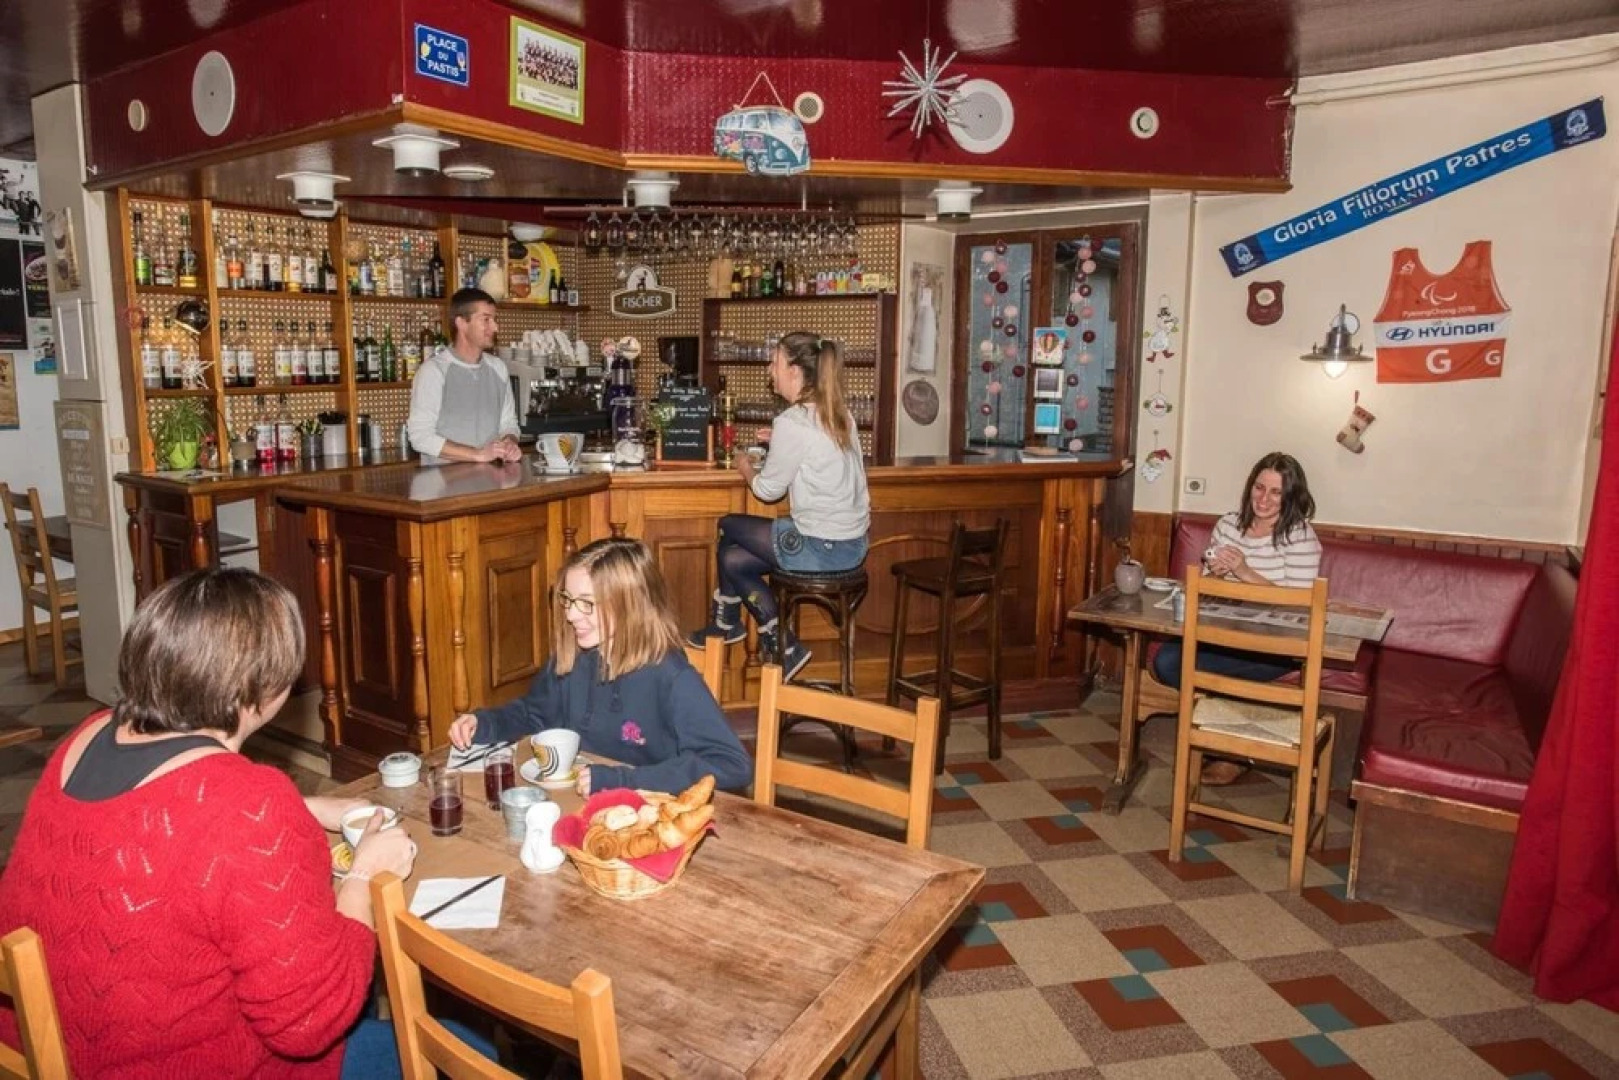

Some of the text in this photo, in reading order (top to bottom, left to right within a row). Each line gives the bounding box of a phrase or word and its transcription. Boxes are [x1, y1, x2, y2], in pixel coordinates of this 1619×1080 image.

[427, 33, 457, 52] PLACE
[427, 59, 460, 77] PASTIS
[1273, 132, 1532, 242] Gloria Filiorum Patres
[622, 296, 662, 308] FISCHER
[1418, 322, 1495, 338] HYUNDAI
[1425, 348, 1452, 374] G
[1485, 350, 1501, 365] G
